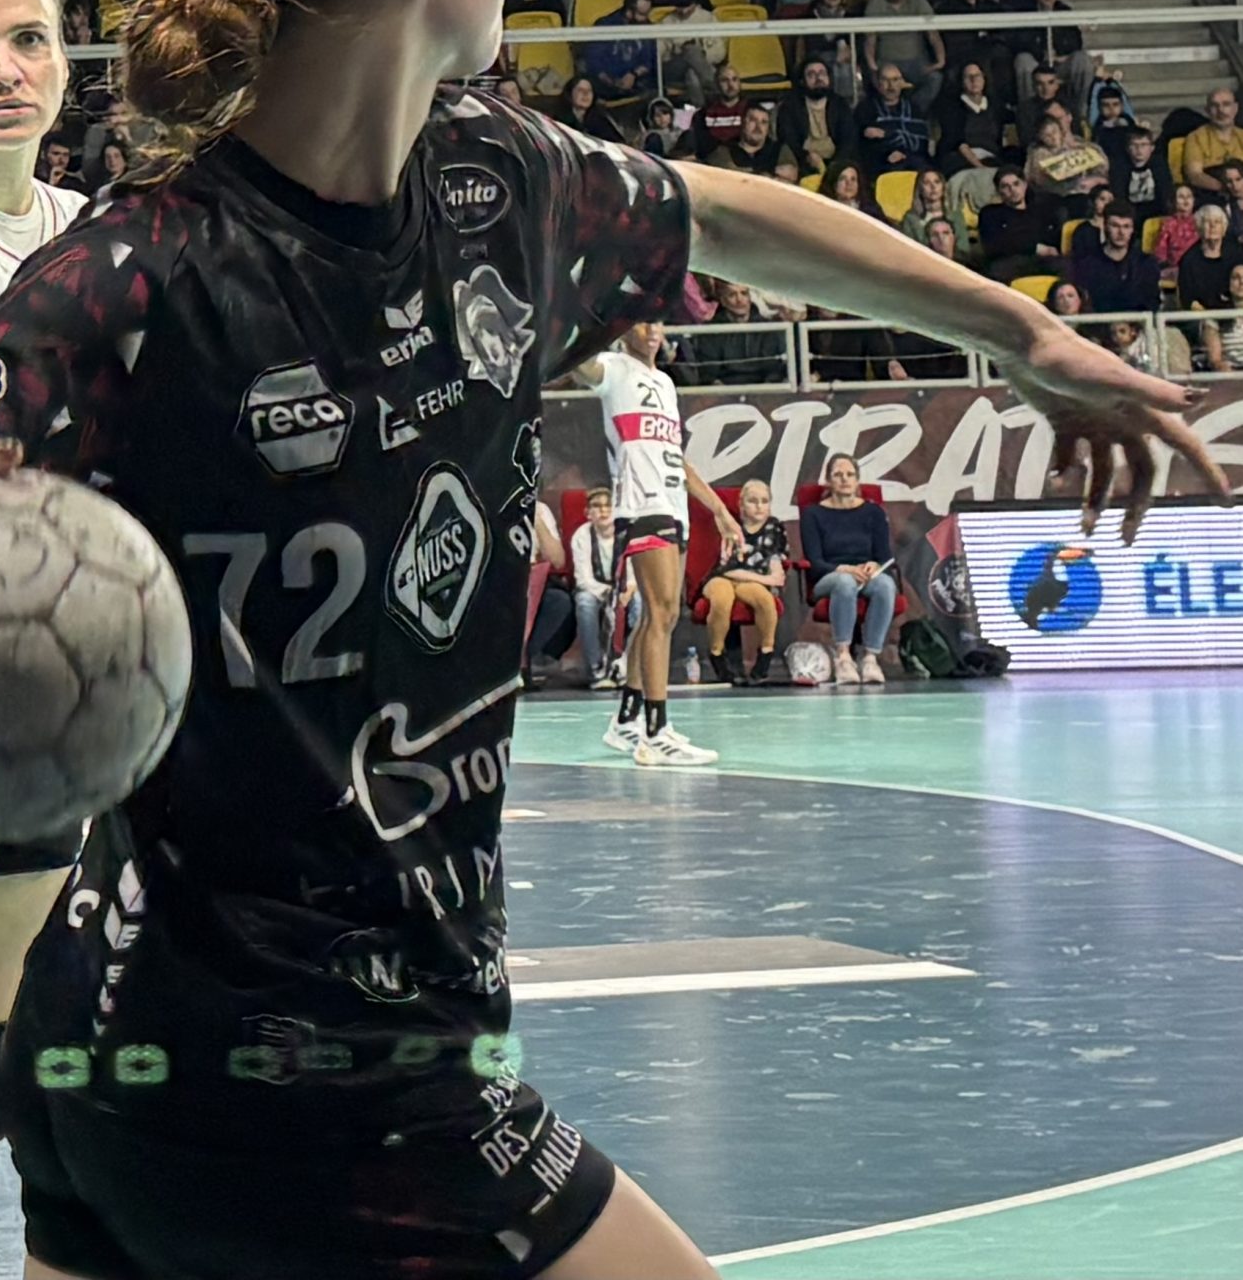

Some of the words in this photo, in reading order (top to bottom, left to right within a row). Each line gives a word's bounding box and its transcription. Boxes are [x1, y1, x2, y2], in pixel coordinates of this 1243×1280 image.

[251, 399, 345, 440] reca
[416, 379, 465, 420] FEHR
[417, 523, 467, 587] NUSS
[182, 522, 367, 688] 72
[480, 1121, 530, 1177] DES
